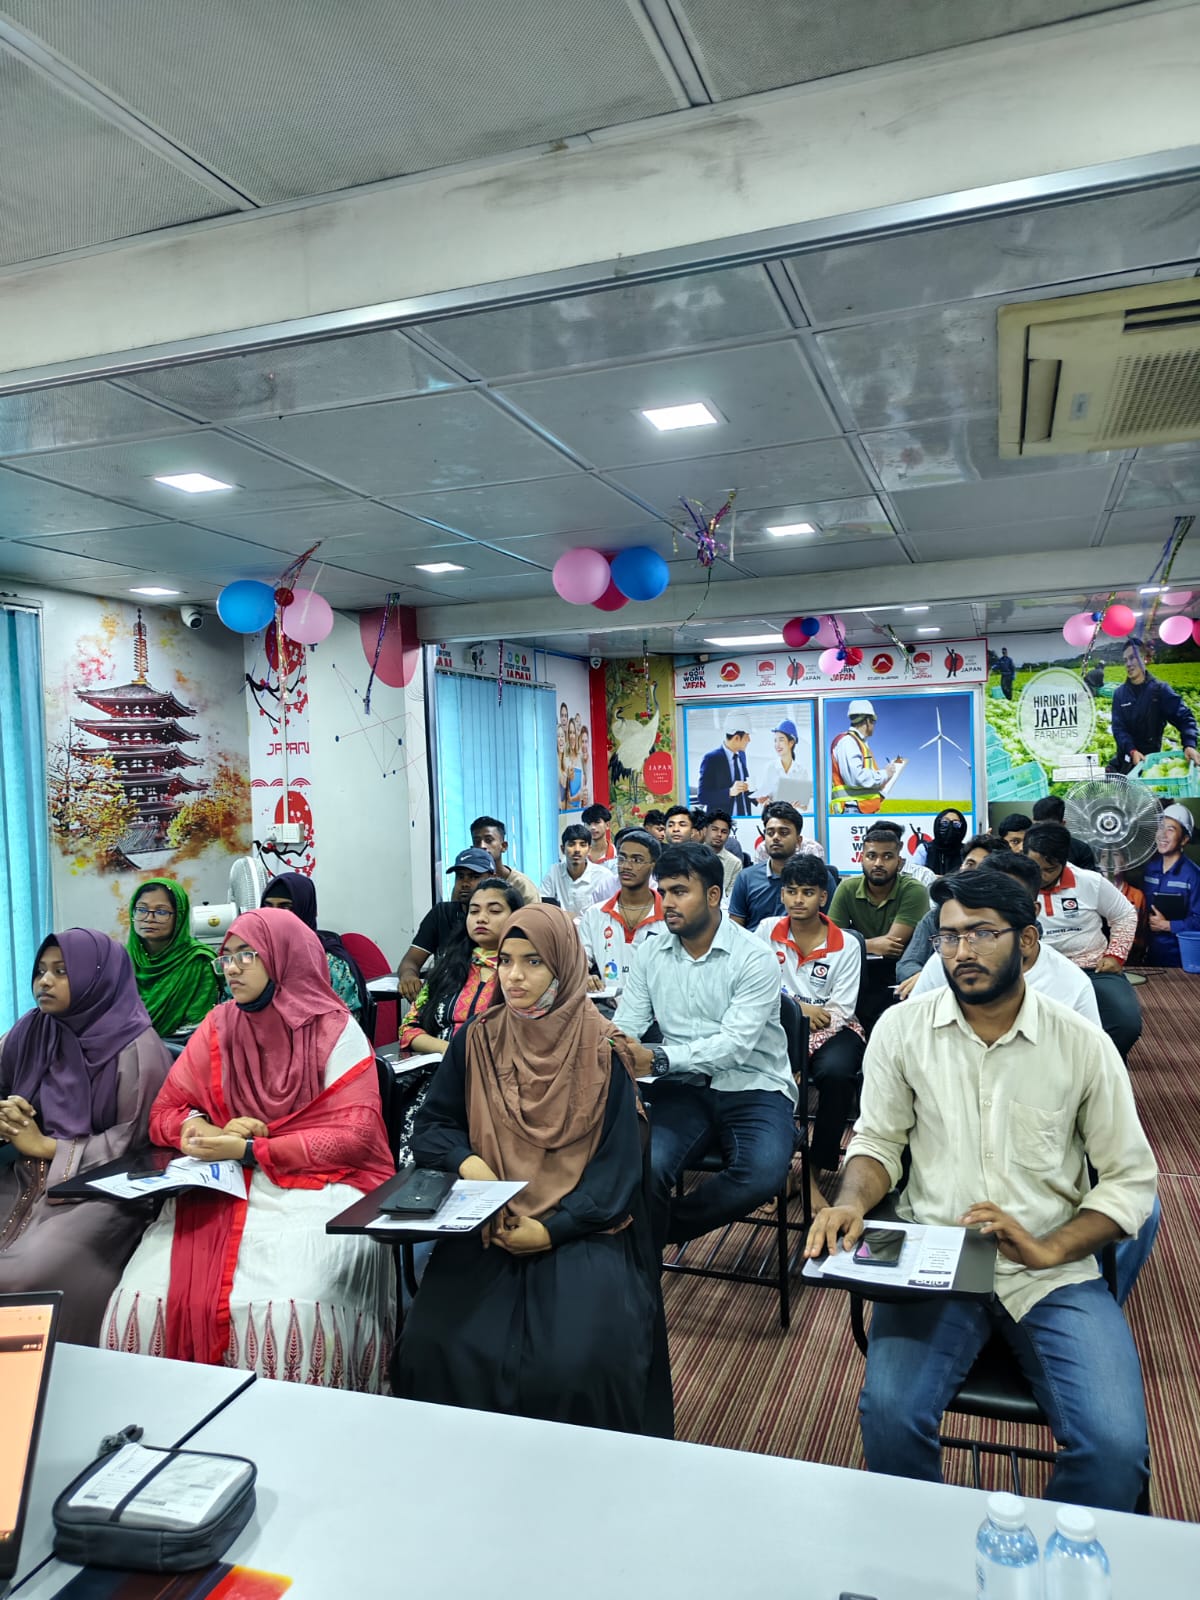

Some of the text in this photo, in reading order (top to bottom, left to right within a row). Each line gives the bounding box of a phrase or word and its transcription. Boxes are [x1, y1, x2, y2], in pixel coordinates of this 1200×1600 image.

[830, 673, 856, 681] JAPAN
[683, 681, 706, 689] JAPAN
[1033, 692, 1077, 708] HIRING IN
[1034, 706, 1078, 728] JAPAN
[1034, 729, 1079, 740] FARMERS
[266, 742, 309, 756] JAPAN
